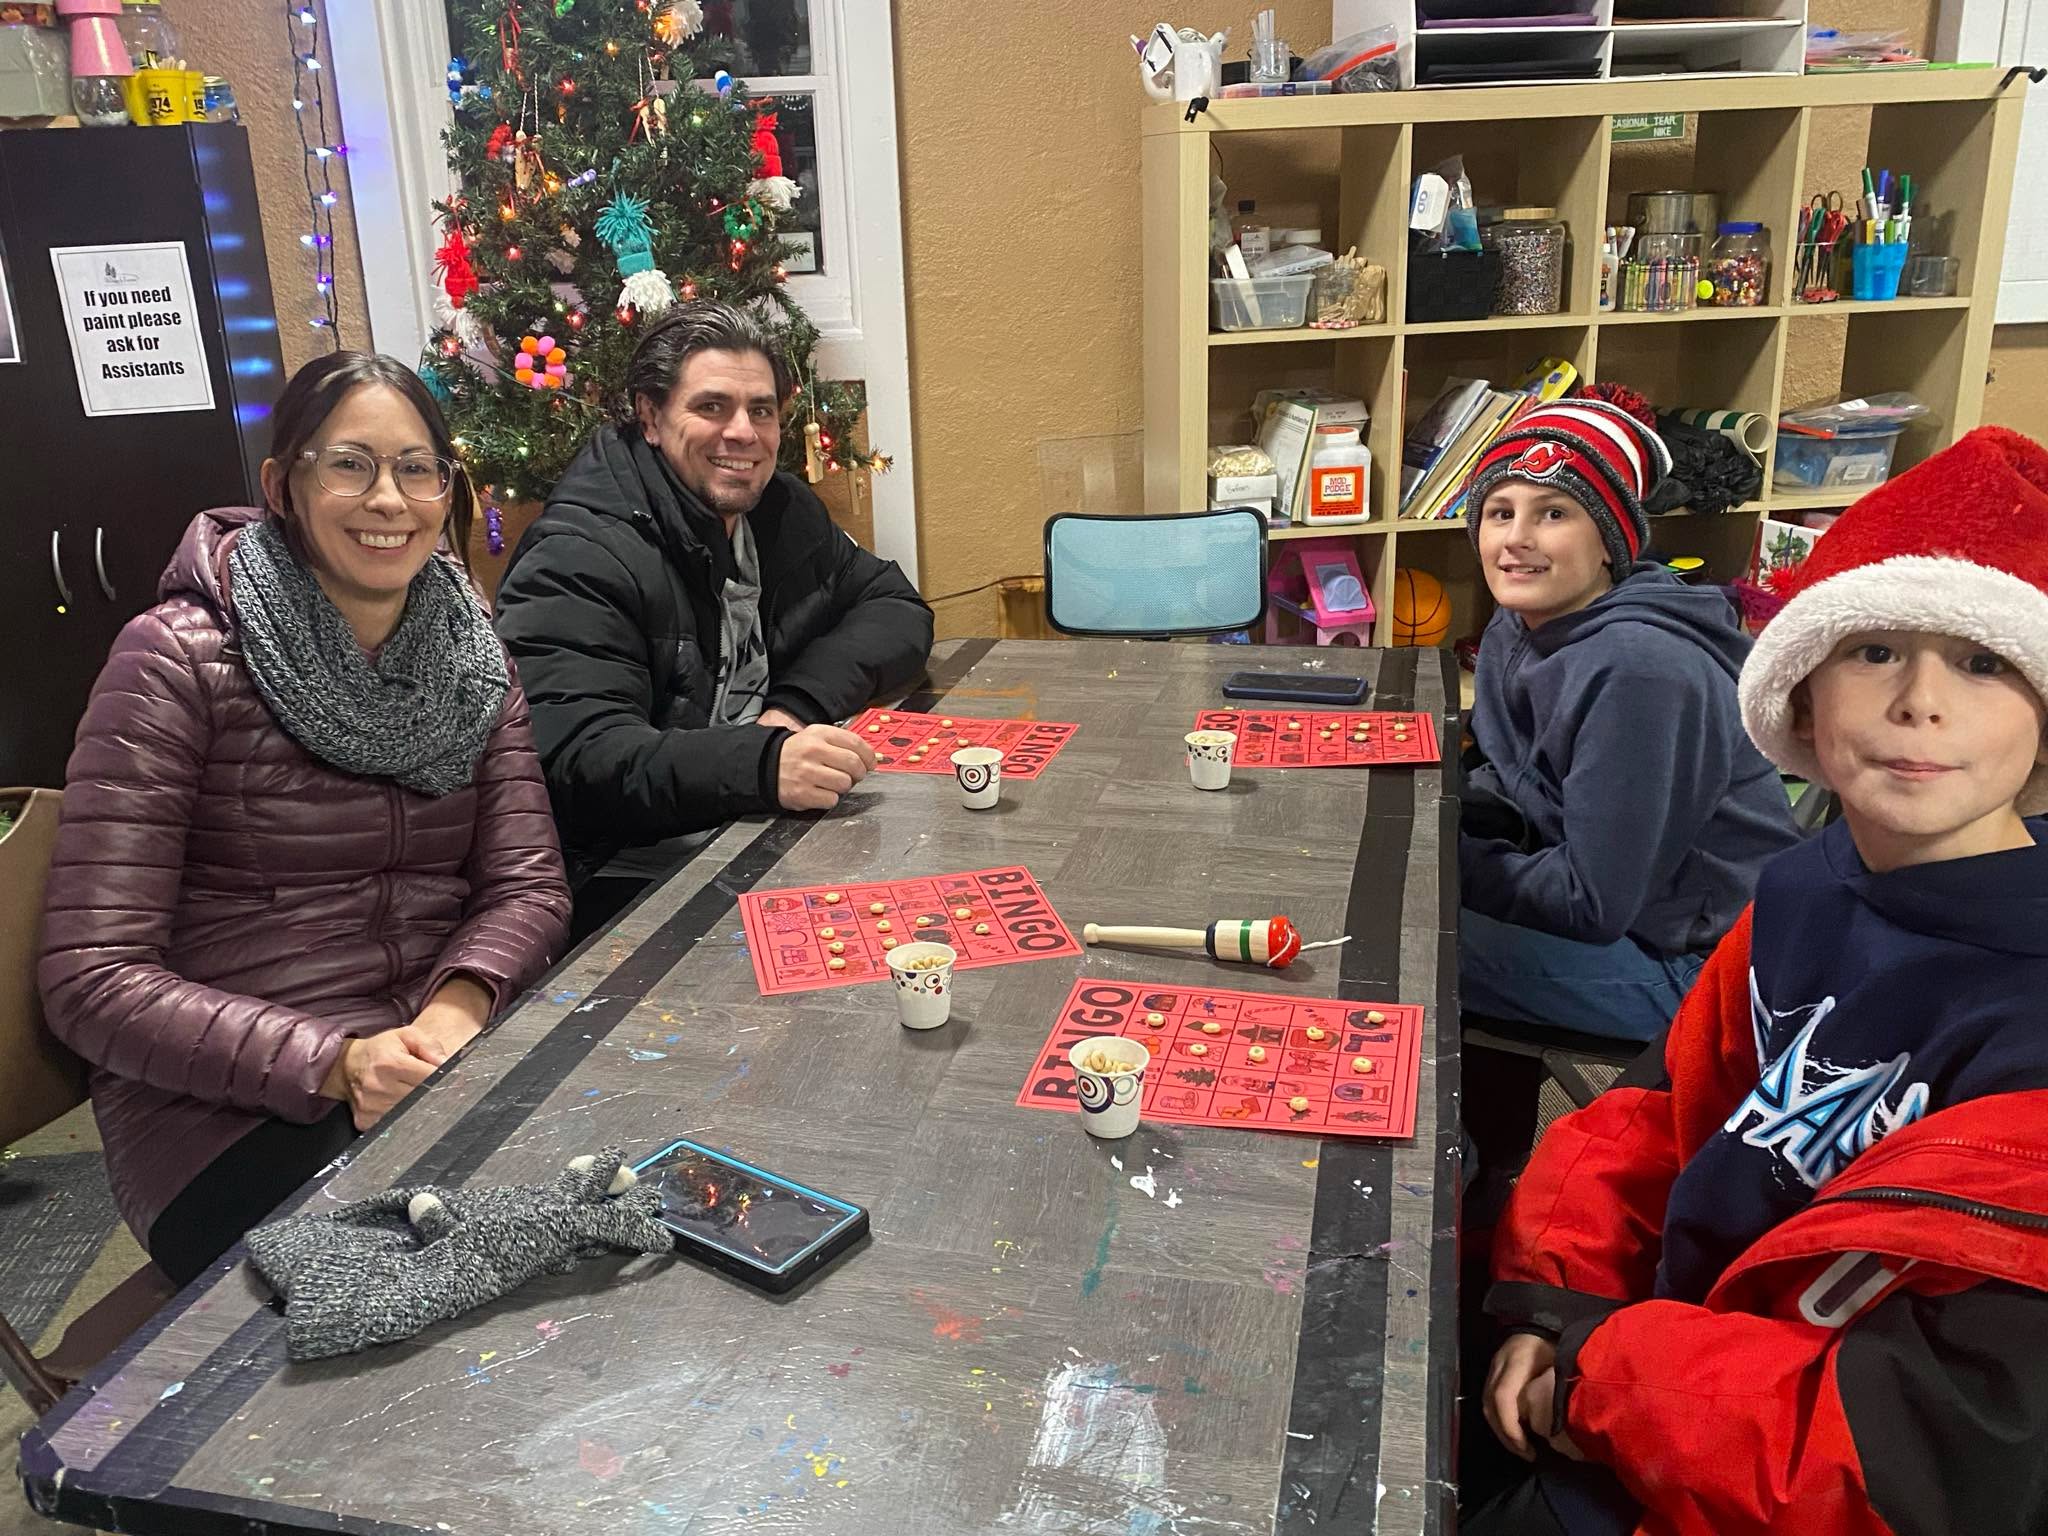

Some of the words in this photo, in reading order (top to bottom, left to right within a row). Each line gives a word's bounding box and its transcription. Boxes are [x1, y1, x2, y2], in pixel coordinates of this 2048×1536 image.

[84, 290, 96, 307] If
[98, 290, 128, 307] you
[131, 286, 171, 304] need
[83, 313, 125, 332] paint
[127, 311, 182, 330] please
[106, 336, 135, 353] ask
[138, 336, 160, 351] for
[102, 360, 185, 379] Assistants
[1324, 484, 1352, 493] PODGE
[1329, 477, 1347, 485] MOD
[1000, 725, 1071, 774] BINGO
[978, 871, 1067, 951] BINGO
